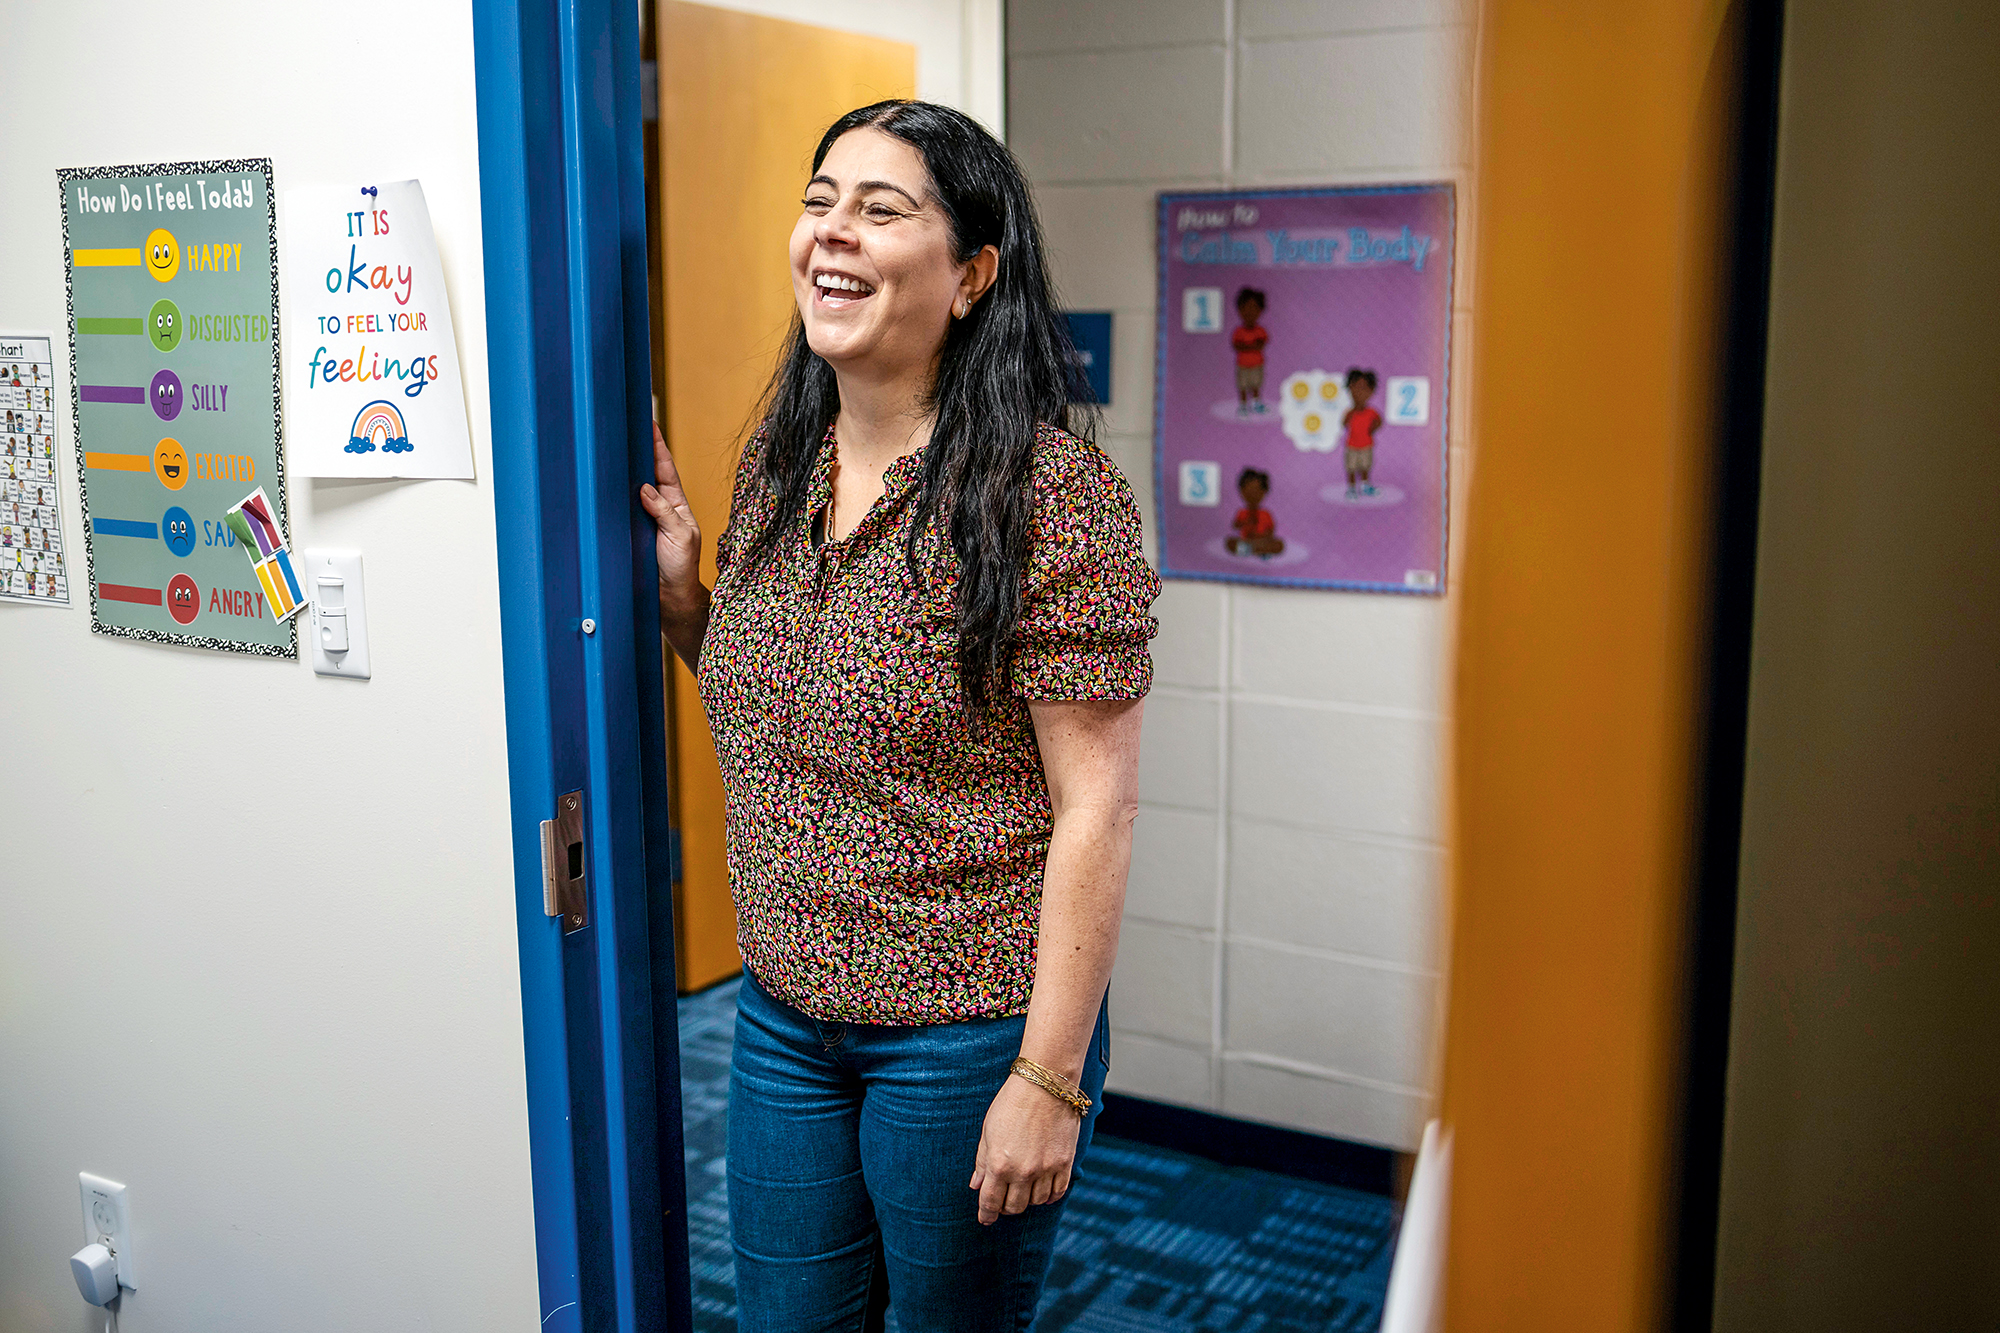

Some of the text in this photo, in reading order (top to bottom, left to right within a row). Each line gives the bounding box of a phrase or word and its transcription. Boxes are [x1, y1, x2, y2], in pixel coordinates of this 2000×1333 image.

[77, 179, 254, 214] How Do I Feel Today
[347, 209, 390, 237] IT IS
[187, 243, 242, 272] HAPPY
[1181, 224, 1431, 272] Calm Your Body
[326, 243, 412, 306] okay
[318, 312, 428, 334] TO FEEL YOUR
[1195, 295, 1211, 327] 1
[189, 314, 269, 342] DISGUSTED
[0, 342, 23, 356] hart
[309, 345, 438, 398] feelings
[192, 384, 228, 412] SILLY
[1399, 384, 1419, 417] 2
[195, 452, 256, 482] EXCITED
[1189, 468, 1208, 500] 3
[203, 520, 236, 548] SAD
[208, 587, 264, 619] ANGRY
